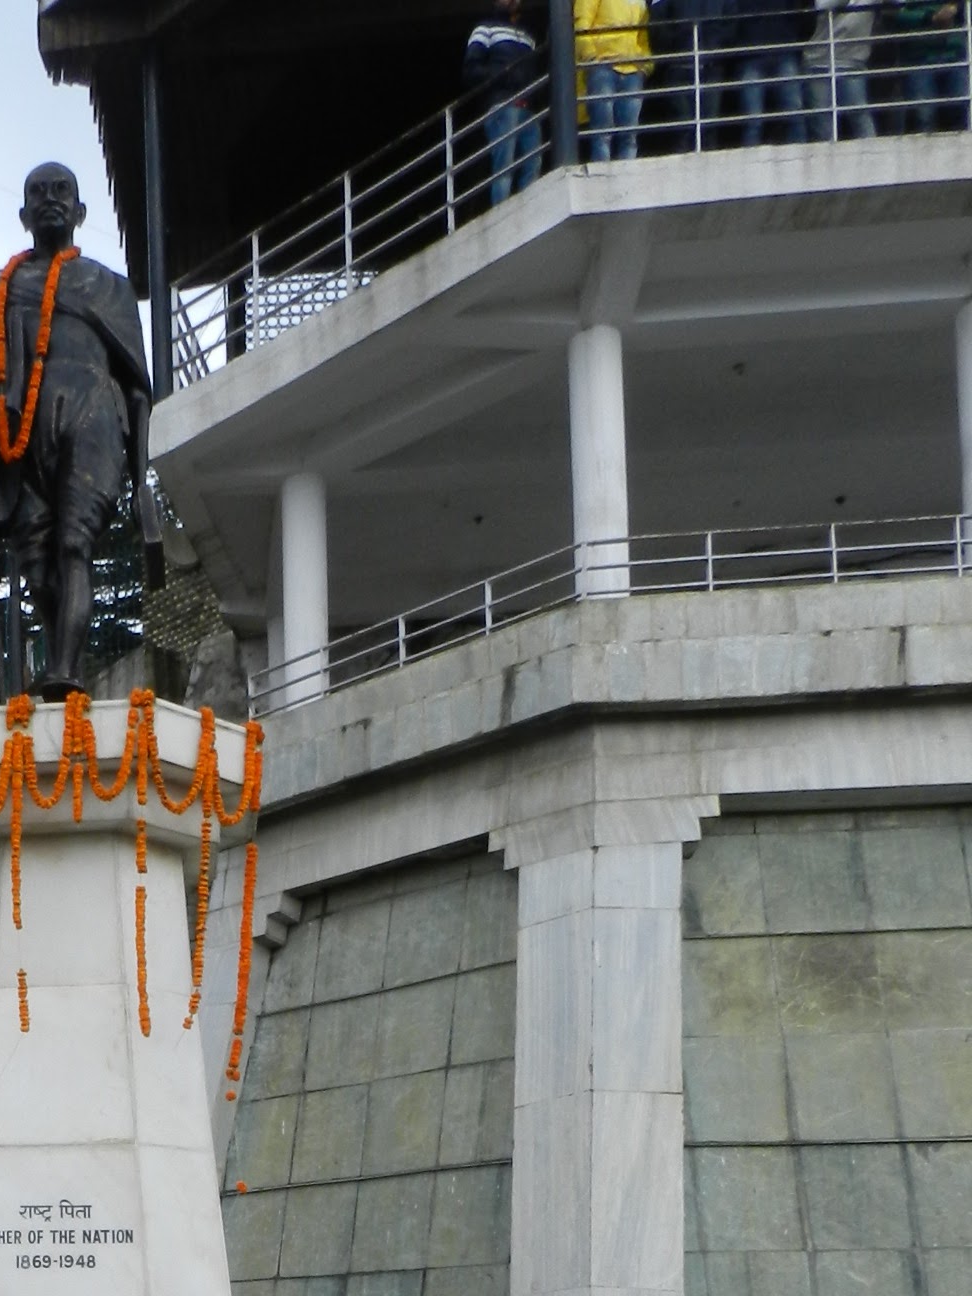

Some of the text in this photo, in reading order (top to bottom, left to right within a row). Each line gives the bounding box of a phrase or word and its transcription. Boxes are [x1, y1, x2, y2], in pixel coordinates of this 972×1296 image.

[19, 1200, 92, 1222] राष्ट्र पिता
[28, 1230, 43, 1244] OF
[50, 1230, 75, 1244] THE
[83, 1230, 133, 1243] NATION
[16, 1255, 96, 1269] 1869-1948
